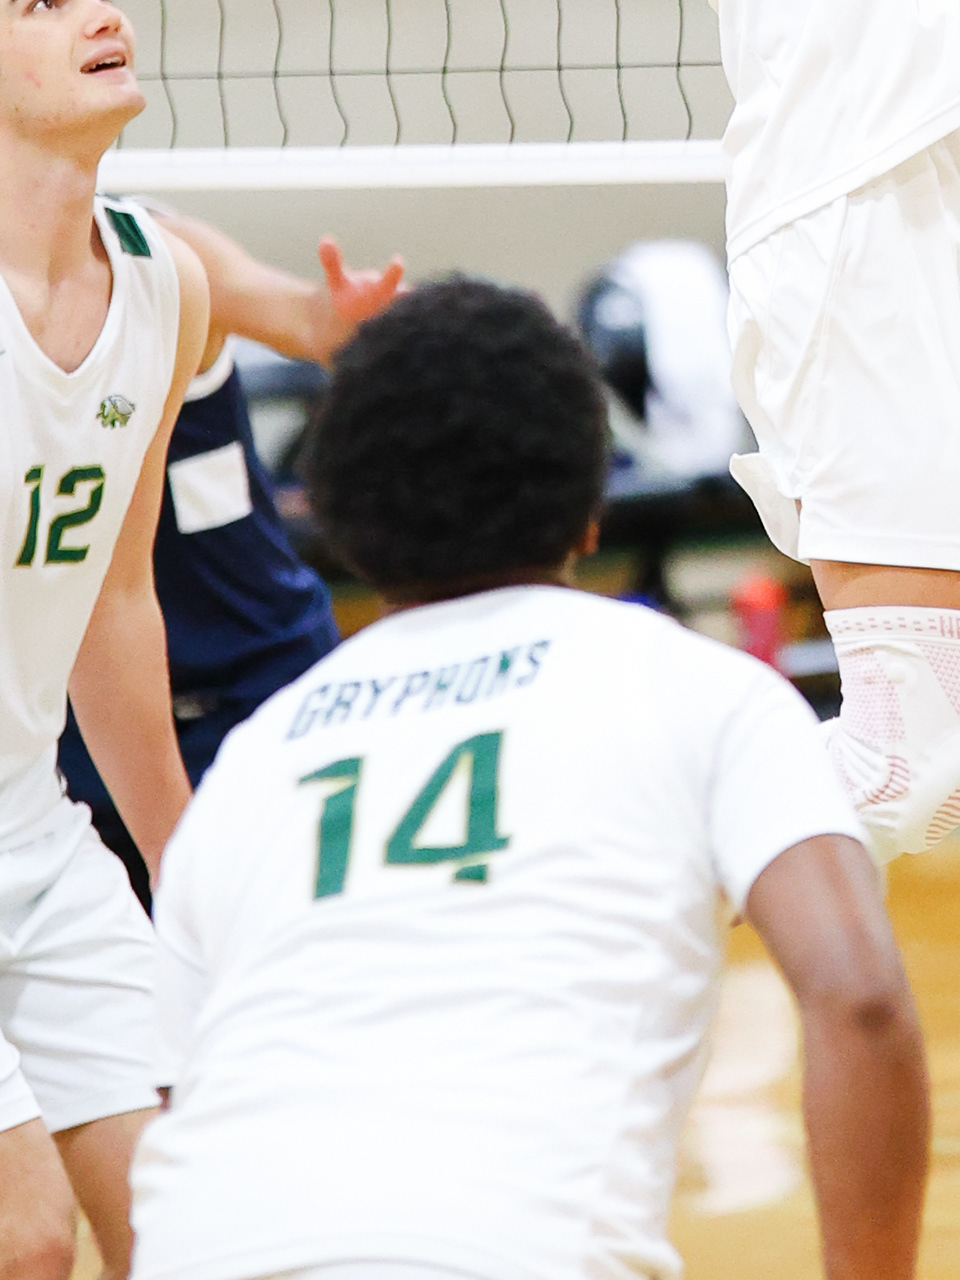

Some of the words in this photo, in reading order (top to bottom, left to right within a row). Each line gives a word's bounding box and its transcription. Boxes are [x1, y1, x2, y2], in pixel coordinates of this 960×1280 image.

[12, 464, 106, 568] 12
[284, 638, 552, 742] GRYPHONS
[297, 728, 512, 902] 14
